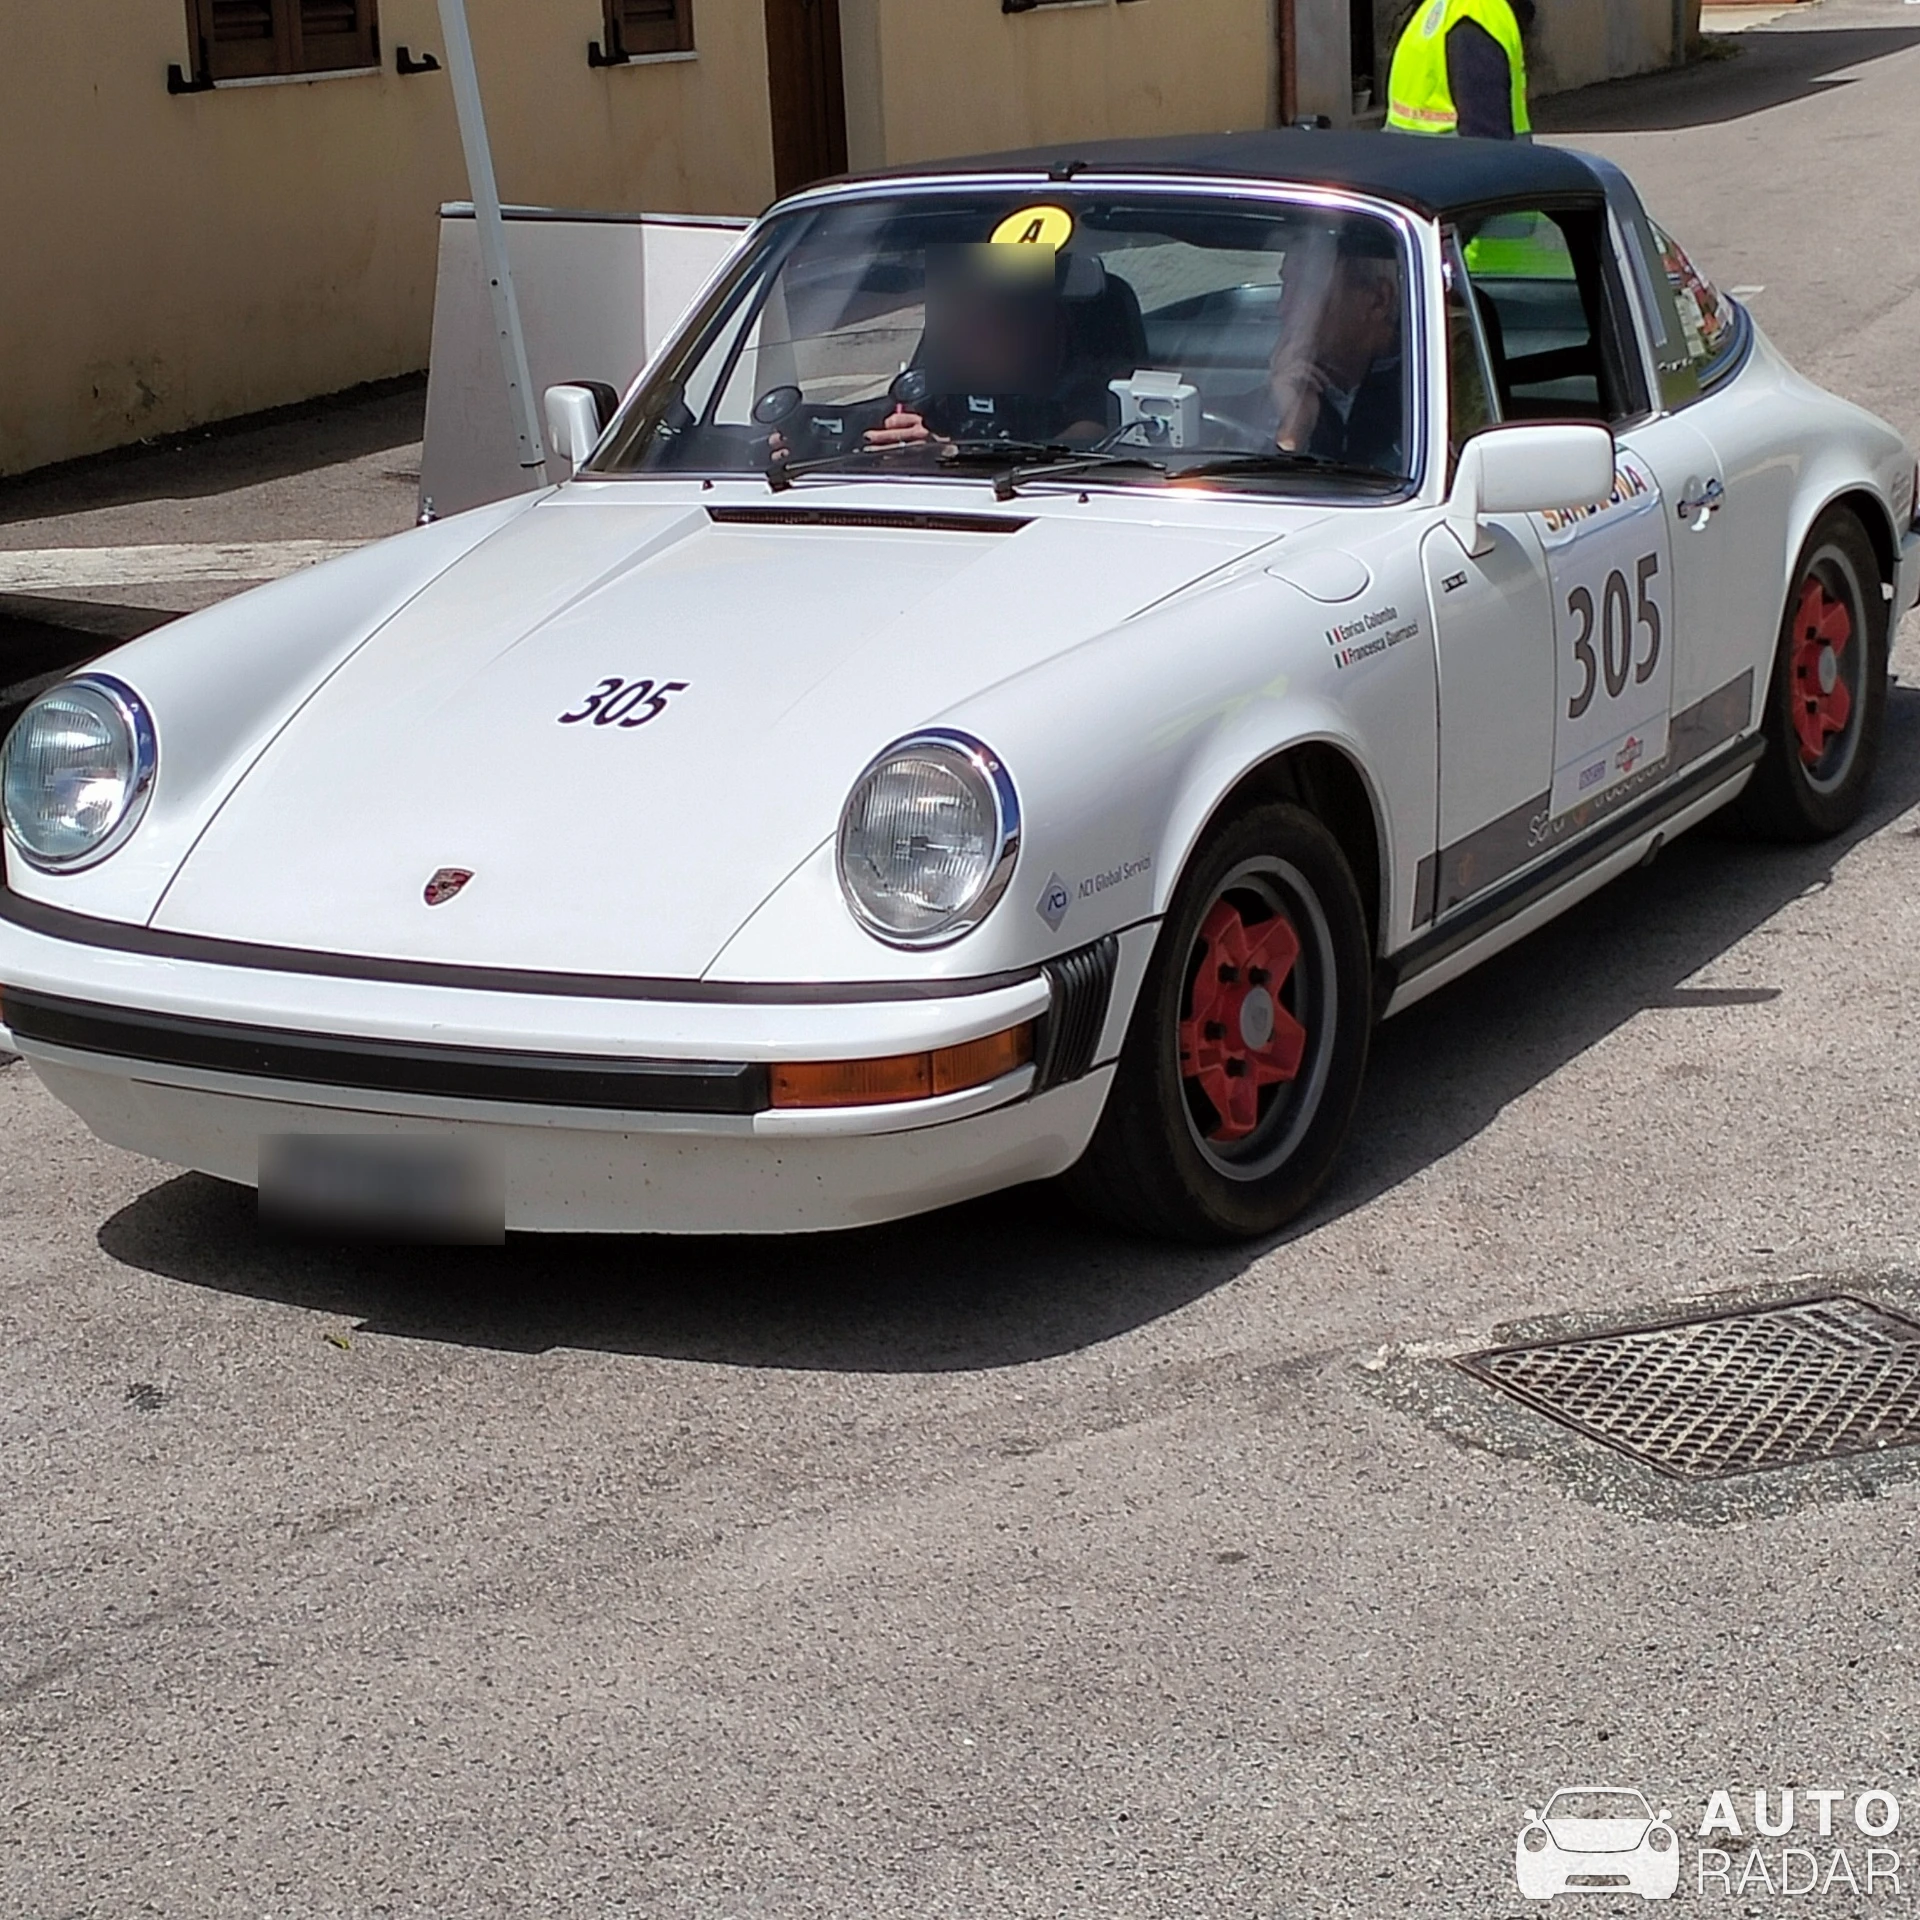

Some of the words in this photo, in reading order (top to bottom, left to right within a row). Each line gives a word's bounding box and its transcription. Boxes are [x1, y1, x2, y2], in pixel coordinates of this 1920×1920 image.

[1016, 218, 1045, 244] A
[1338, 620, 1365, 640] Enrico
[1363, 606, 1397, 629] Colombo
[1568, 552, 1661, 719] 305
[558, 678, 691, 728] 305
[1078, 879, 1094, 900] ACI
[1095, 866, 1122, 892] Global
